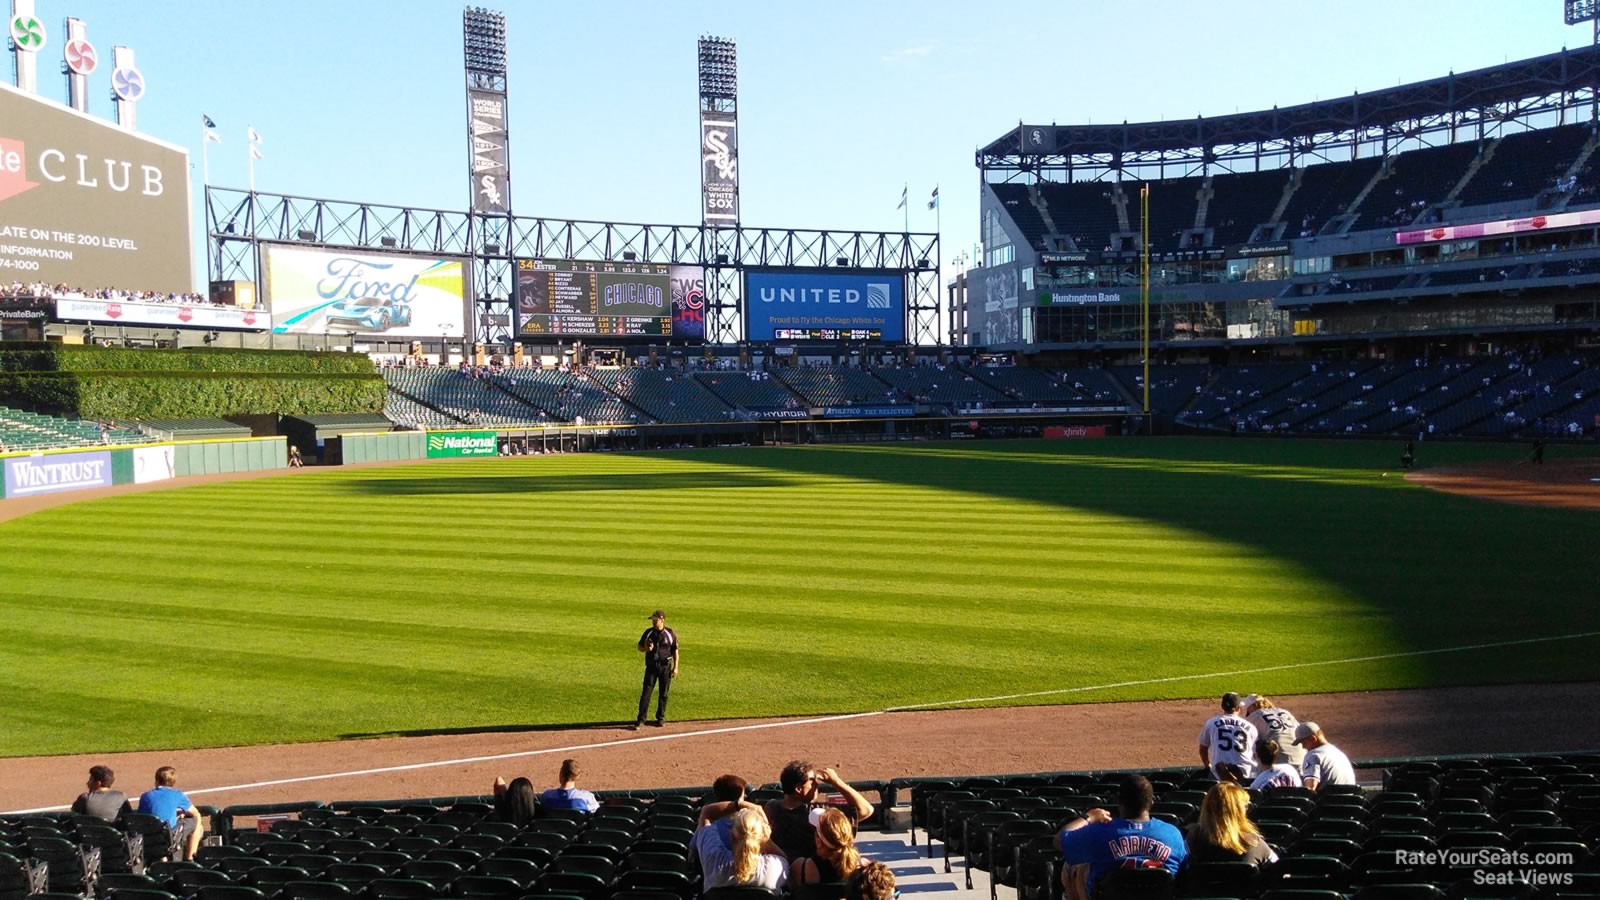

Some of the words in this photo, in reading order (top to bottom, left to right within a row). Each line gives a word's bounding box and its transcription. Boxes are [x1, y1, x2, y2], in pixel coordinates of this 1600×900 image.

[39, 148, 164, 196] CLUB
[708, 199, 734, 209] SOX
[30, 229, 49, 240] ON
[51, 231, 75, 244] THE
[77, 234, 100, 246] 200
[102, 237, 138, 250] LEVEL
[1, 244, 73, 260] INFORMATION
[520, 260, 534, 269] 34
[316, 258, 419, 303] Ford
[605, 283, 663, 308] CHICAGO
[760, 288, 860, 303] UNITED
[1052, 293, 1097, 305] Huntington
[1098, 292, 1120, 302] Bank
[0, 309, 46, 319] PrivateBank
[769, 316, 790, 324] Proud
[800, 316, 810, 325] fly
[811, 316, 824, 324] the
[824, 316, 851, 325] Chicago
[1063, 427, 1087, 438] xfinity
[444, 436, 496, 449] National
[12, 460, 105, 488] WINTRUST
[1214, 717, 1251, 732] CABRERA
[1218, 728, 1247, 752] 53
[1108, 835, 1172, 861] ARRIETA
